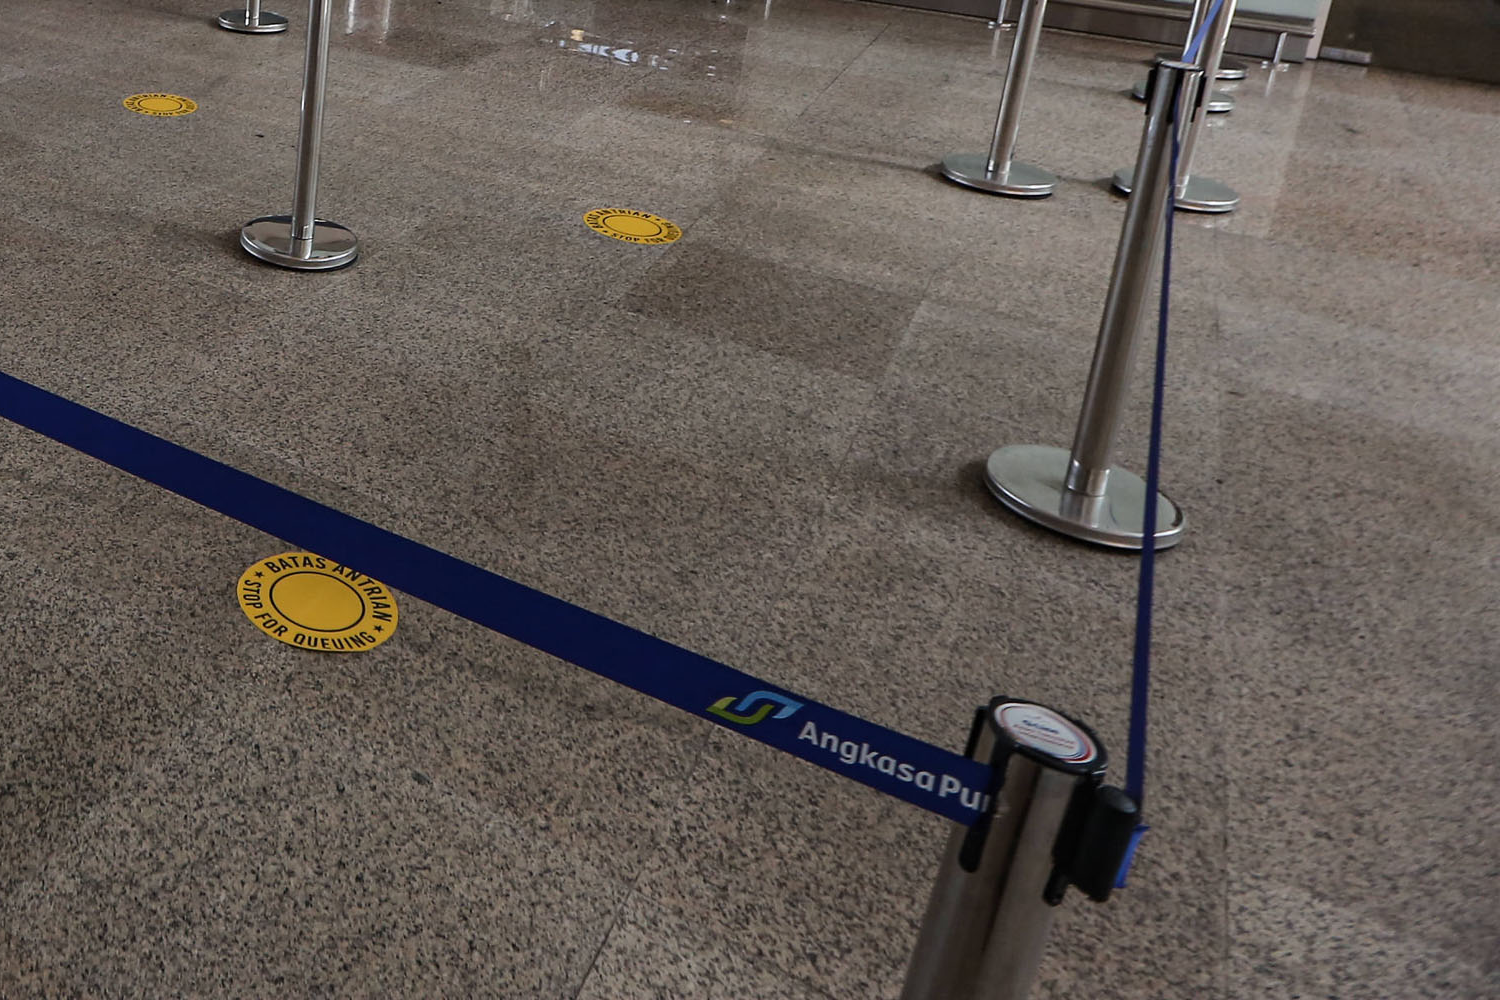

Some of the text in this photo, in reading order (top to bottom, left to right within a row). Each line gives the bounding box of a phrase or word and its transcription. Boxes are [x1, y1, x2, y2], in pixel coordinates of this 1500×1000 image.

[243, 579, 377, 650] STOP FOR QUEUING
[264, 556, 393, 622] BATAS ANTRIAN
